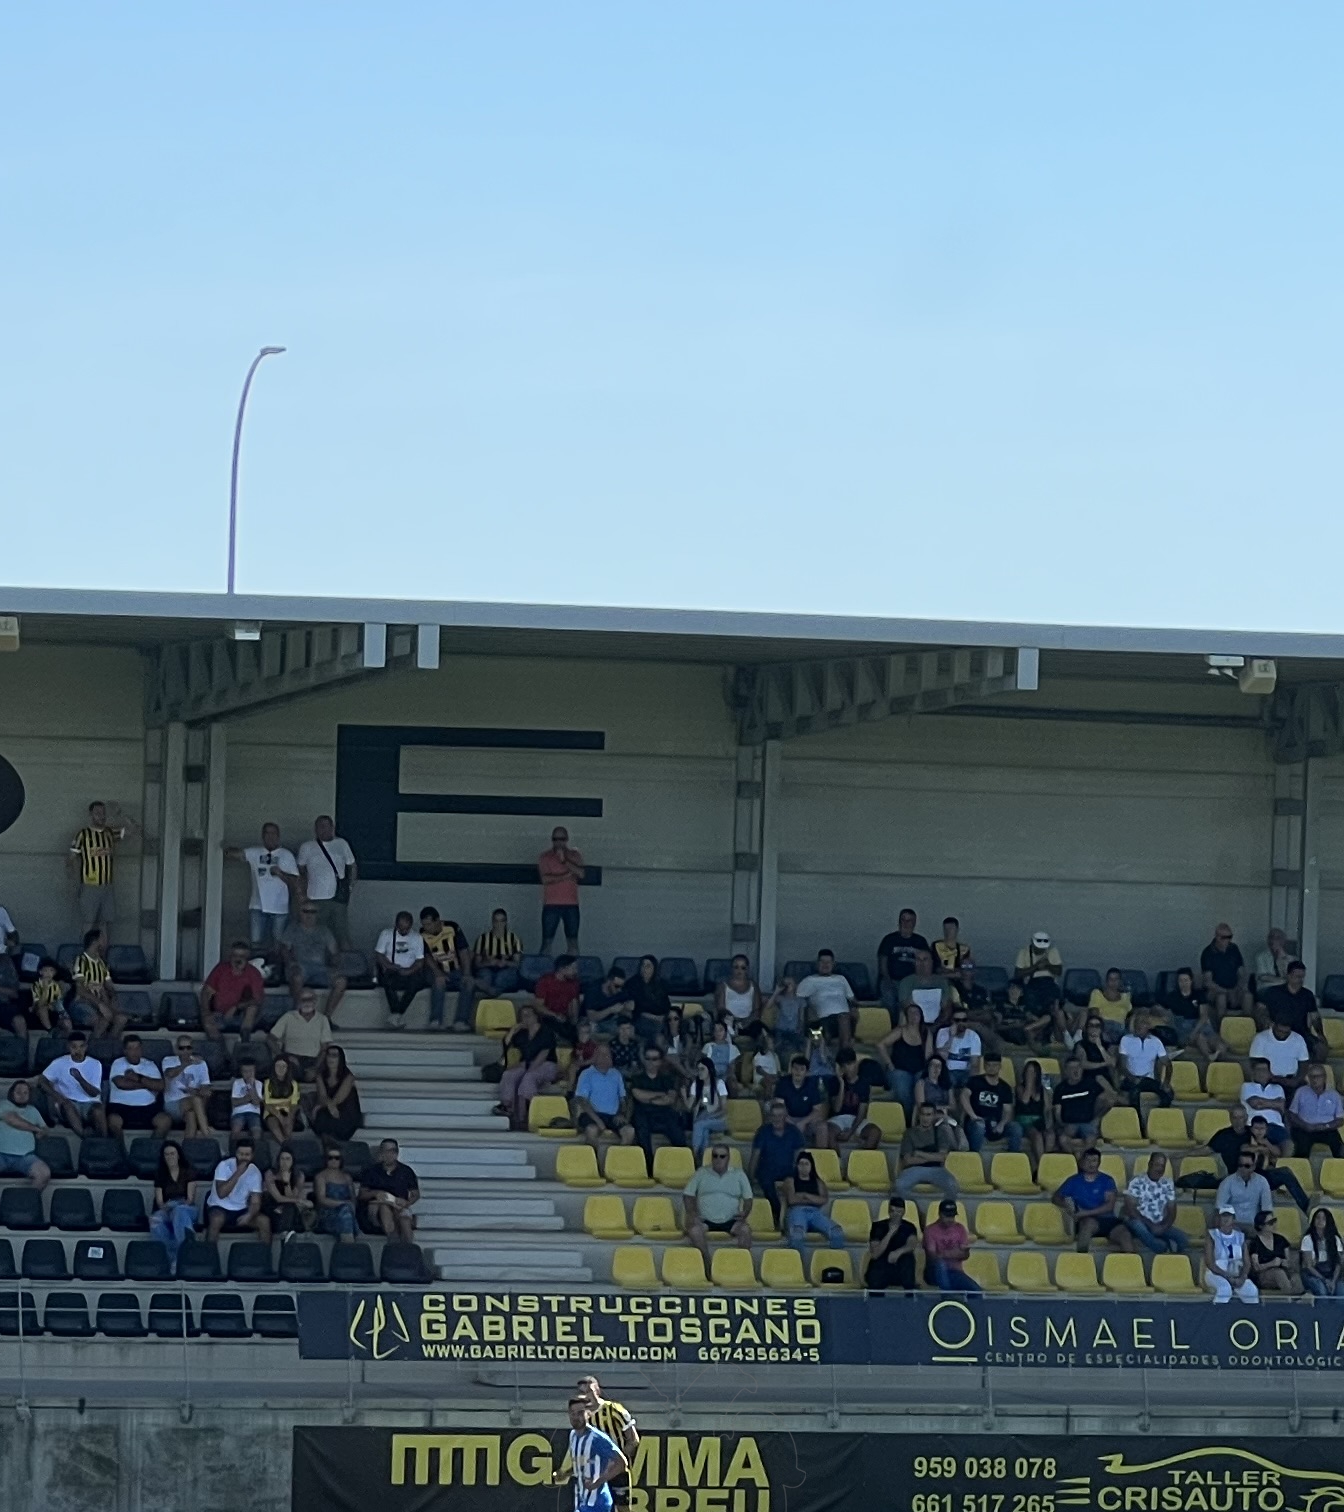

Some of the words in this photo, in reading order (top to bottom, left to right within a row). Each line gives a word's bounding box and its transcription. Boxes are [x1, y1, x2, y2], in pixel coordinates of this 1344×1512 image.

[422, 1294, 816, 1316] CONSTRUCCIONES
[420, 1312, 604, 1343] GABRIEL
[619, 1314, 821, 1345] TOSCANO
[987, 1316, 1190, 1349] ISMAEL
[422, 1343, 677, 1361] WWW.GABRIELTOSCANO.COM
[985, 1351, 1047, 1364] CENTRO
[1057, 1352, 1076, 1364] DE
[1086, 1353, 1219, 1365] ESPECIALIDADES
[506, 1433, 770, 1487] GMMA
[913, 1456, 956, 1478] 959
[964, 1457, 1006, 1478] 038
[1014, 1457, 1056, 1479] 078
[1168, 1470, 1281, 1486] TALLER
[1097, 1487, 1284, 1511] CRISAUTO
